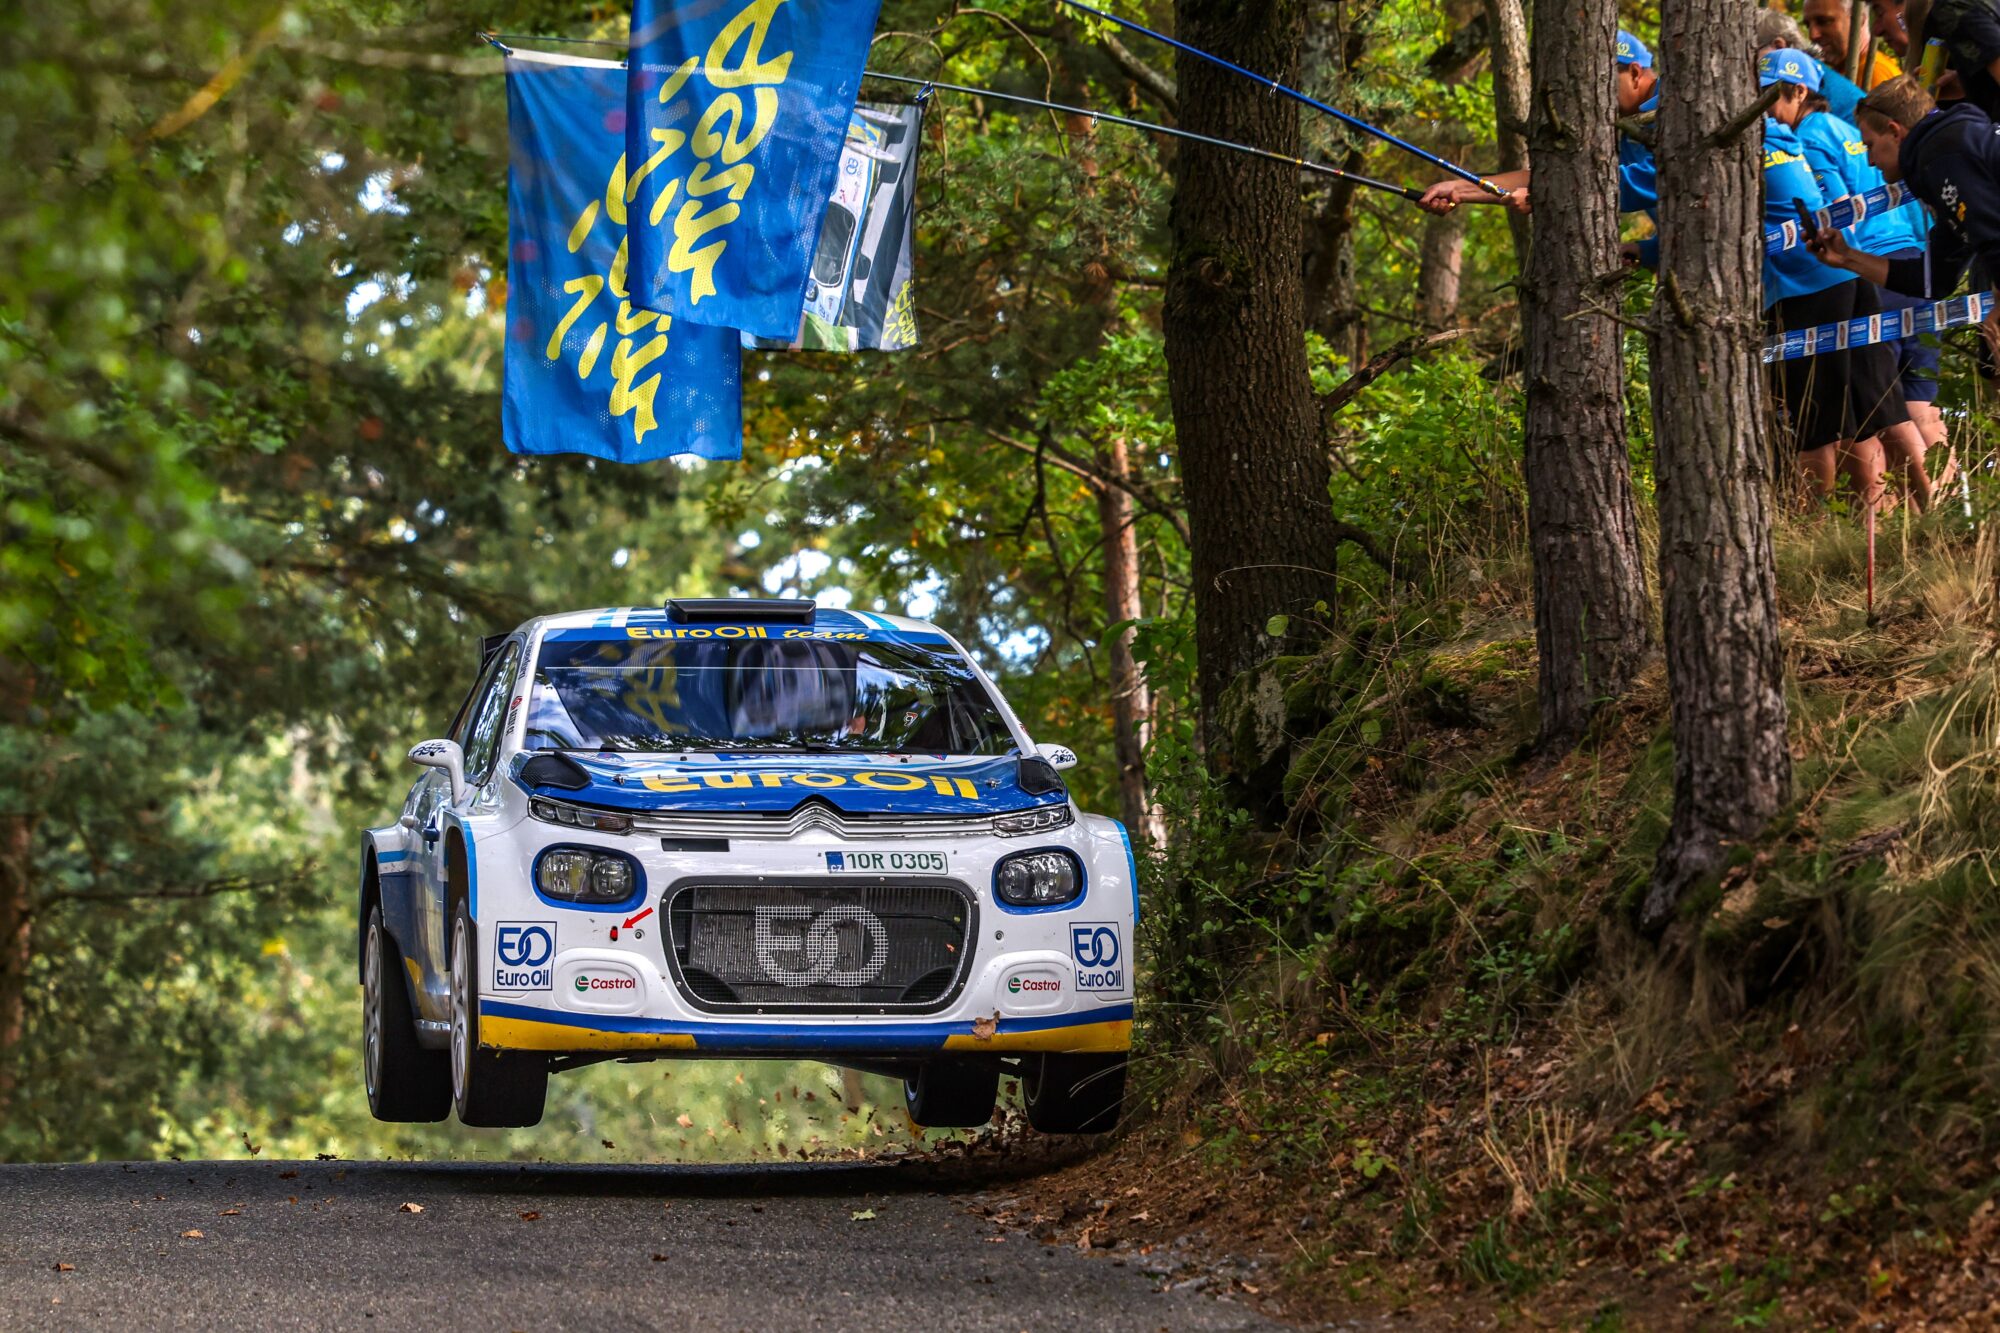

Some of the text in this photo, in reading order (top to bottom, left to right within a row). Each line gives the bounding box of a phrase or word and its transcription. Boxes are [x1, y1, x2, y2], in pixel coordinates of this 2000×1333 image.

[626, 626, 870, 640] EuroOil team
[642, 771, 979, 800] EuroOil
[830, 863, 843, 872] CZ
[847, 853, 944, 871] 10R 0305
[498, 926, 552, 967] EO
[1073, 927, 1119, 967] EO
[591, 978, 636, 990] Castrol
[1022, 979, 1061, 991] Castrol
